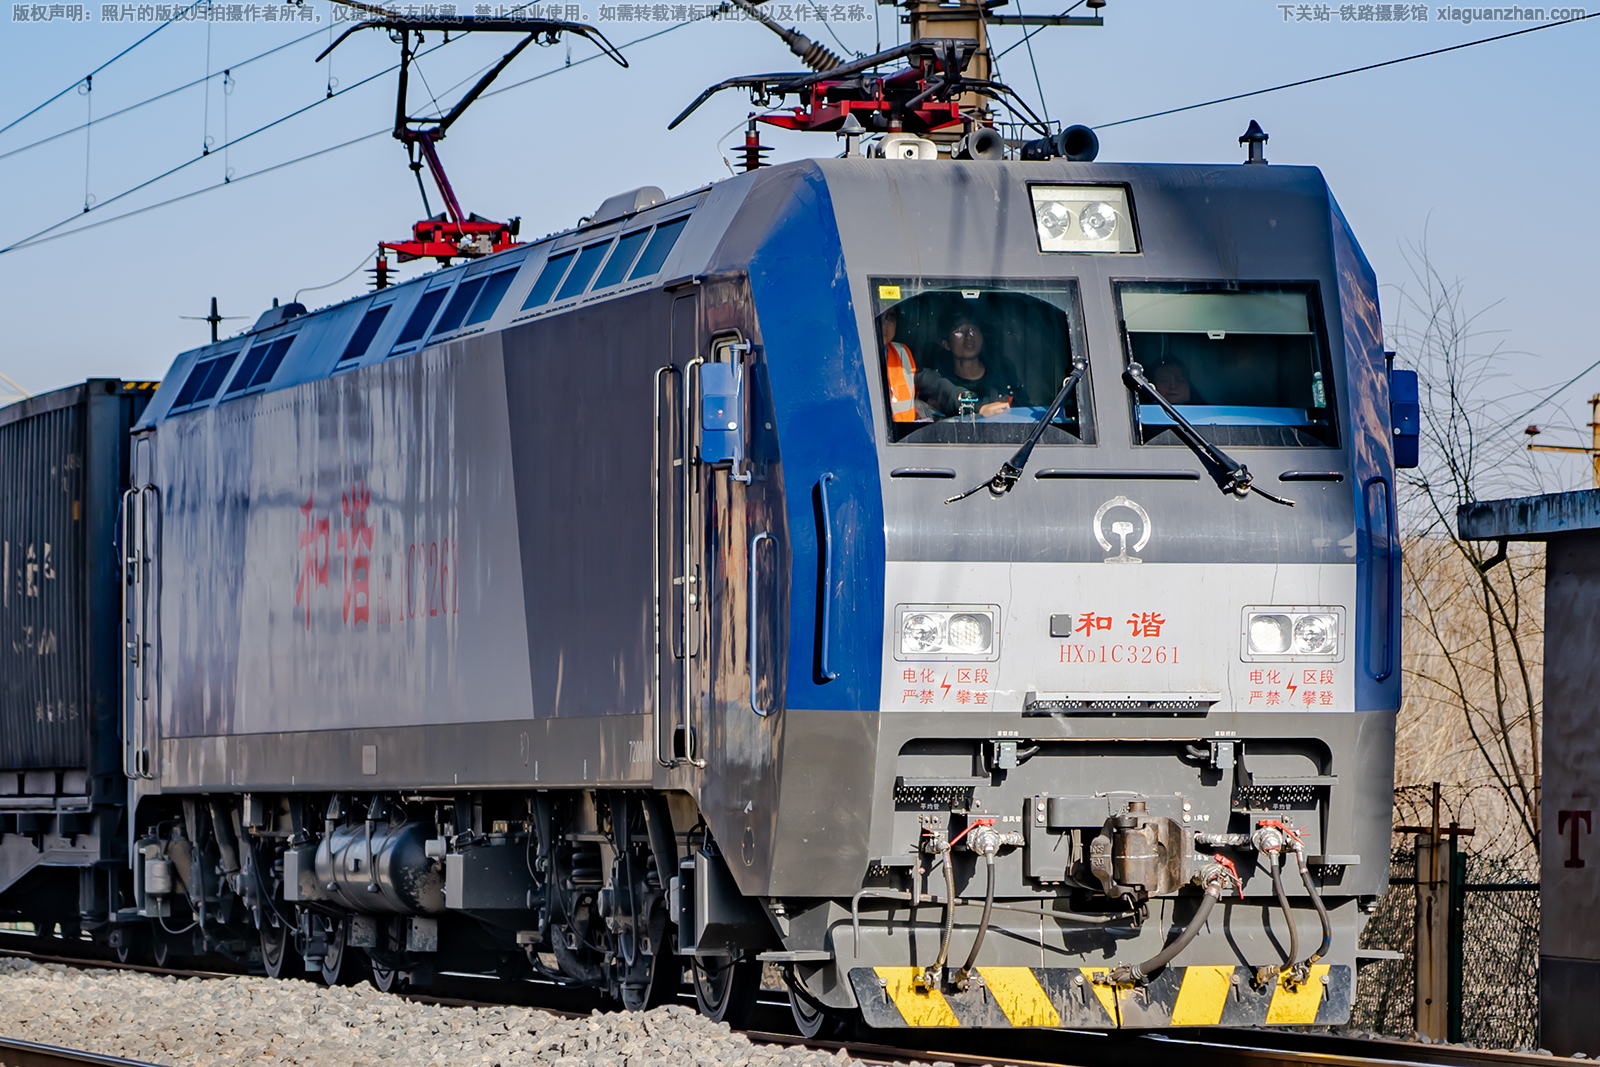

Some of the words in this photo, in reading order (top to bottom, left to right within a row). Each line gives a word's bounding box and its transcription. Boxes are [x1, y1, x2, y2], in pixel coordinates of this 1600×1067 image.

[1075, 611, 1166, 638] 和谐
[1059, 644, 1180, 664] HXD1C3261
[903, 668, 935, 684] 电化
[957, 668, 989, 684] 区段
[1249, 669, 1281, 685] 电化
[1303, 669, 1334, 685] 区段
[902, 689, 934, 704] 严禁
[956, 689, 989, 705] 攀登
[1248, 690, 1280, 706] 严禁
[1302, 690, 1334, 706] 攀登
